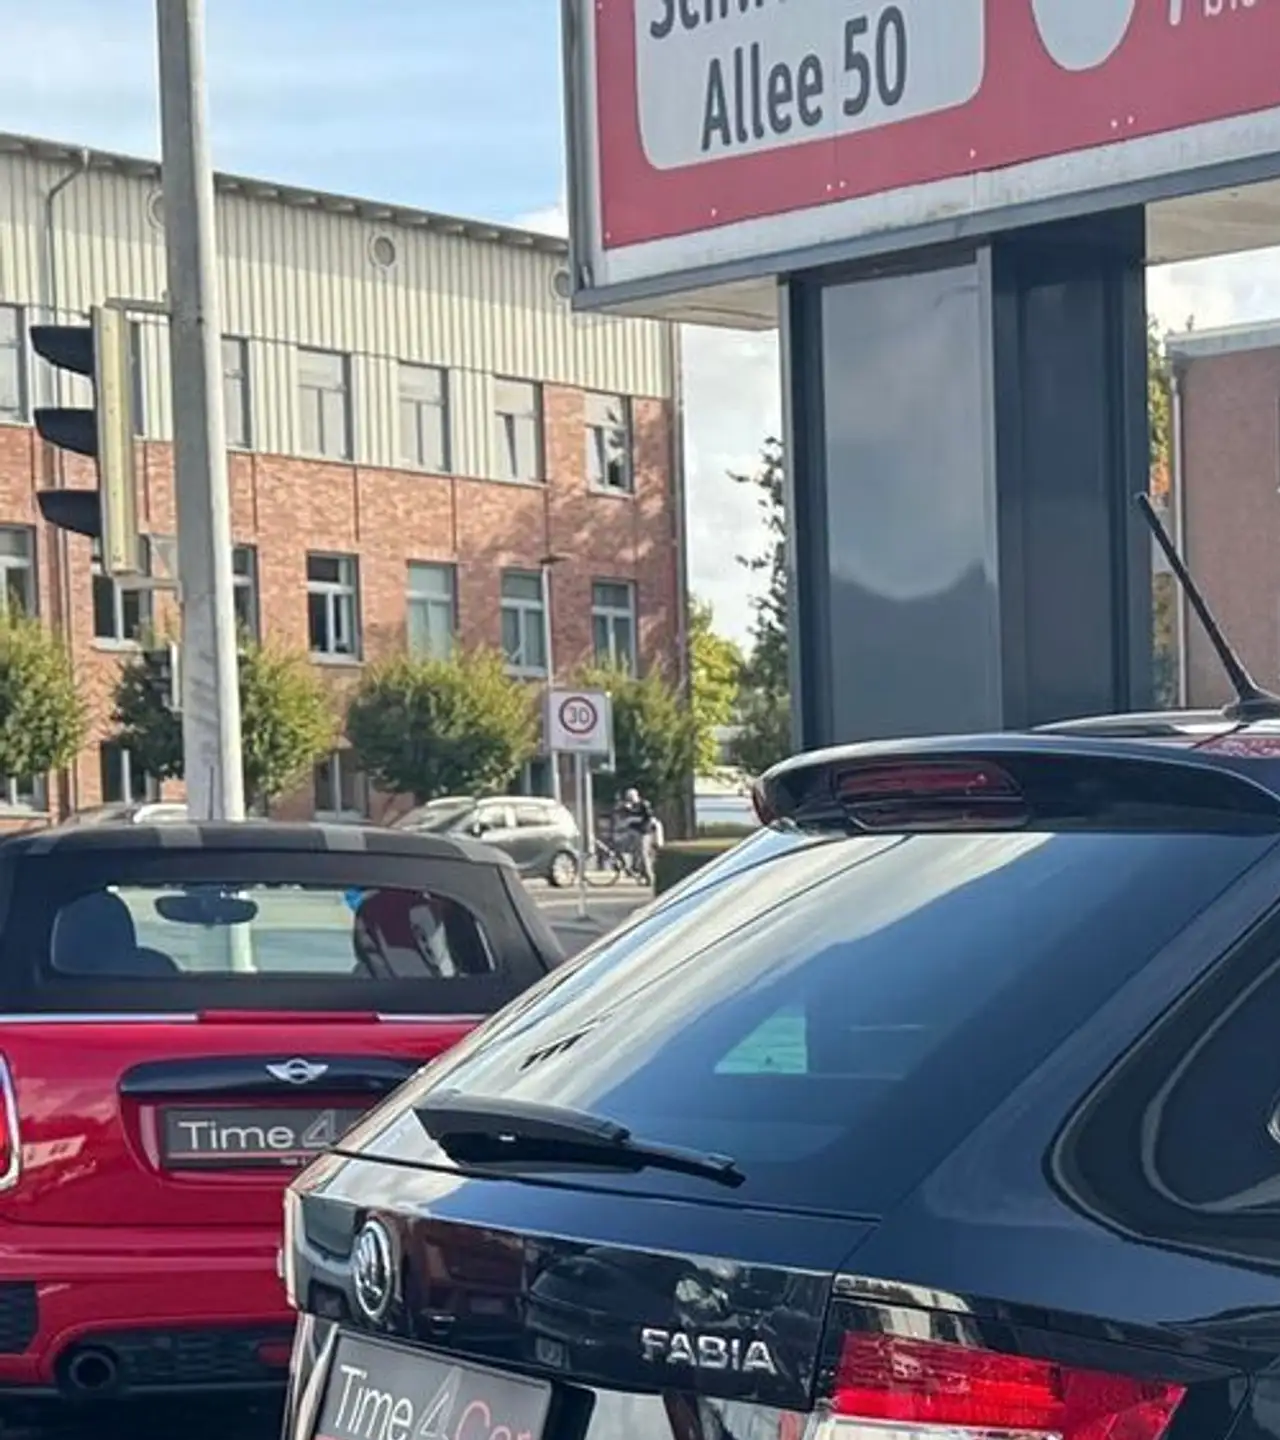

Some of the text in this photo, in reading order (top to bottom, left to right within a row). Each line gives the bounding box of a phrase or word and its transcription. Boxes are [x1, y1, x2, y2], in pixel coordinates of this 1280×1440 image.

[701, 5, 908, 152] Allee 50
[567, 706, 590, 724] 30
[641, 1328, 777, 1376] FABIA
